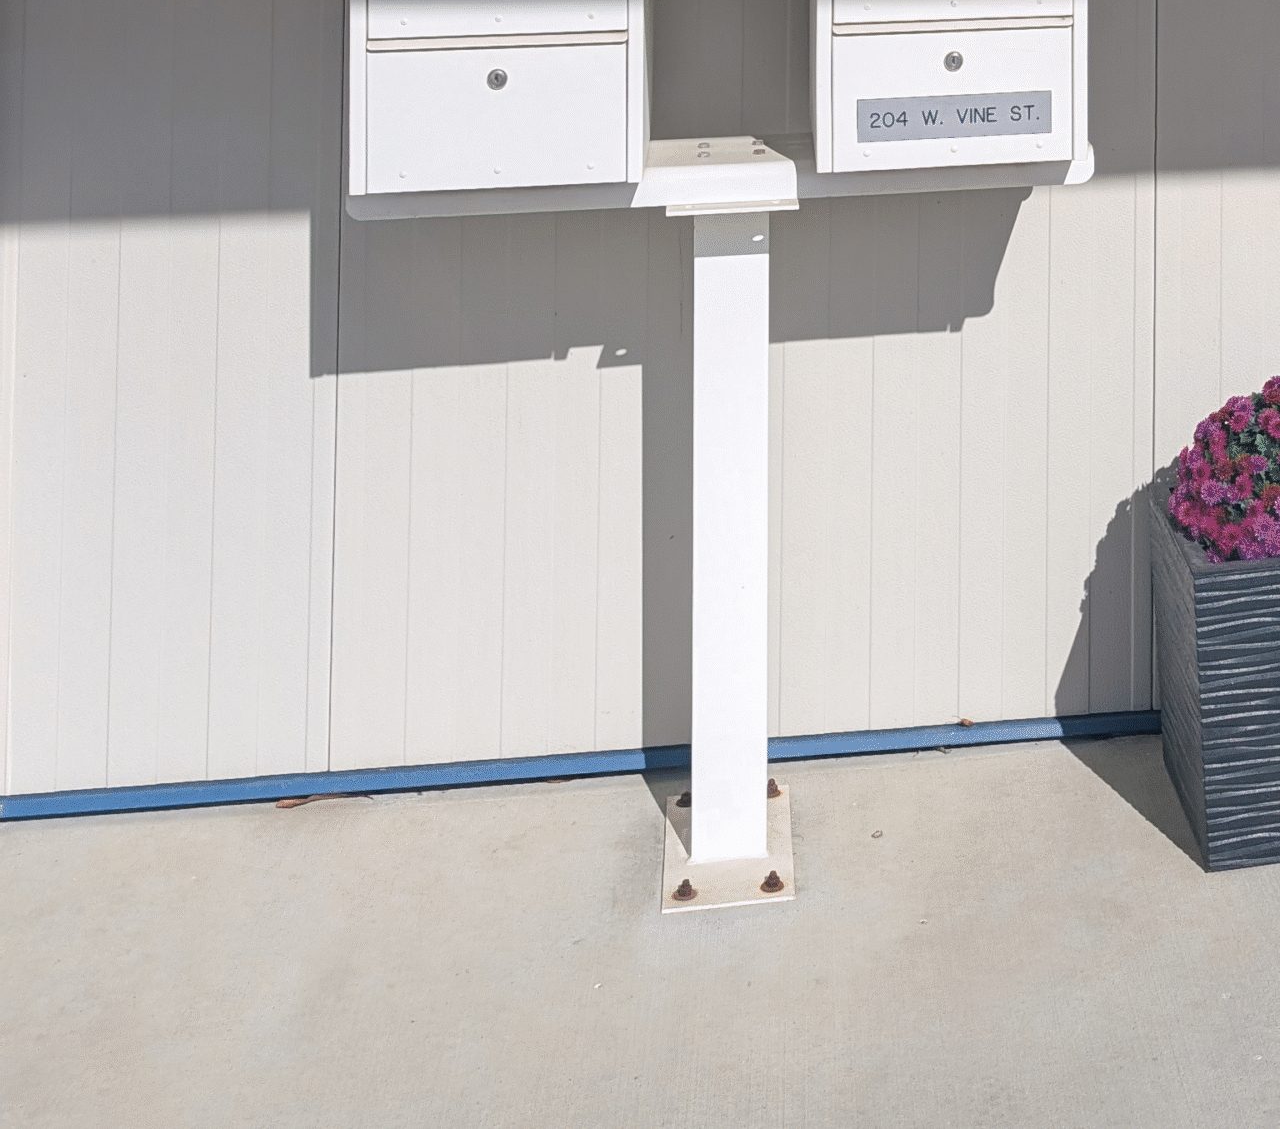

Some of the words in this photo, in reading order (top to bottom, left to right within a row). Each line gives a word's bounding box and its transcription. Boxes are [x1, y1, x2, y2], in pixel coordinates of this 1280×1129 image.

[869, 110, 909, 129] 204
[922, 109, 944, 126] W.
[956, 106, 998, 125] VINE
[1009, 104, 1040, 122] ST.
